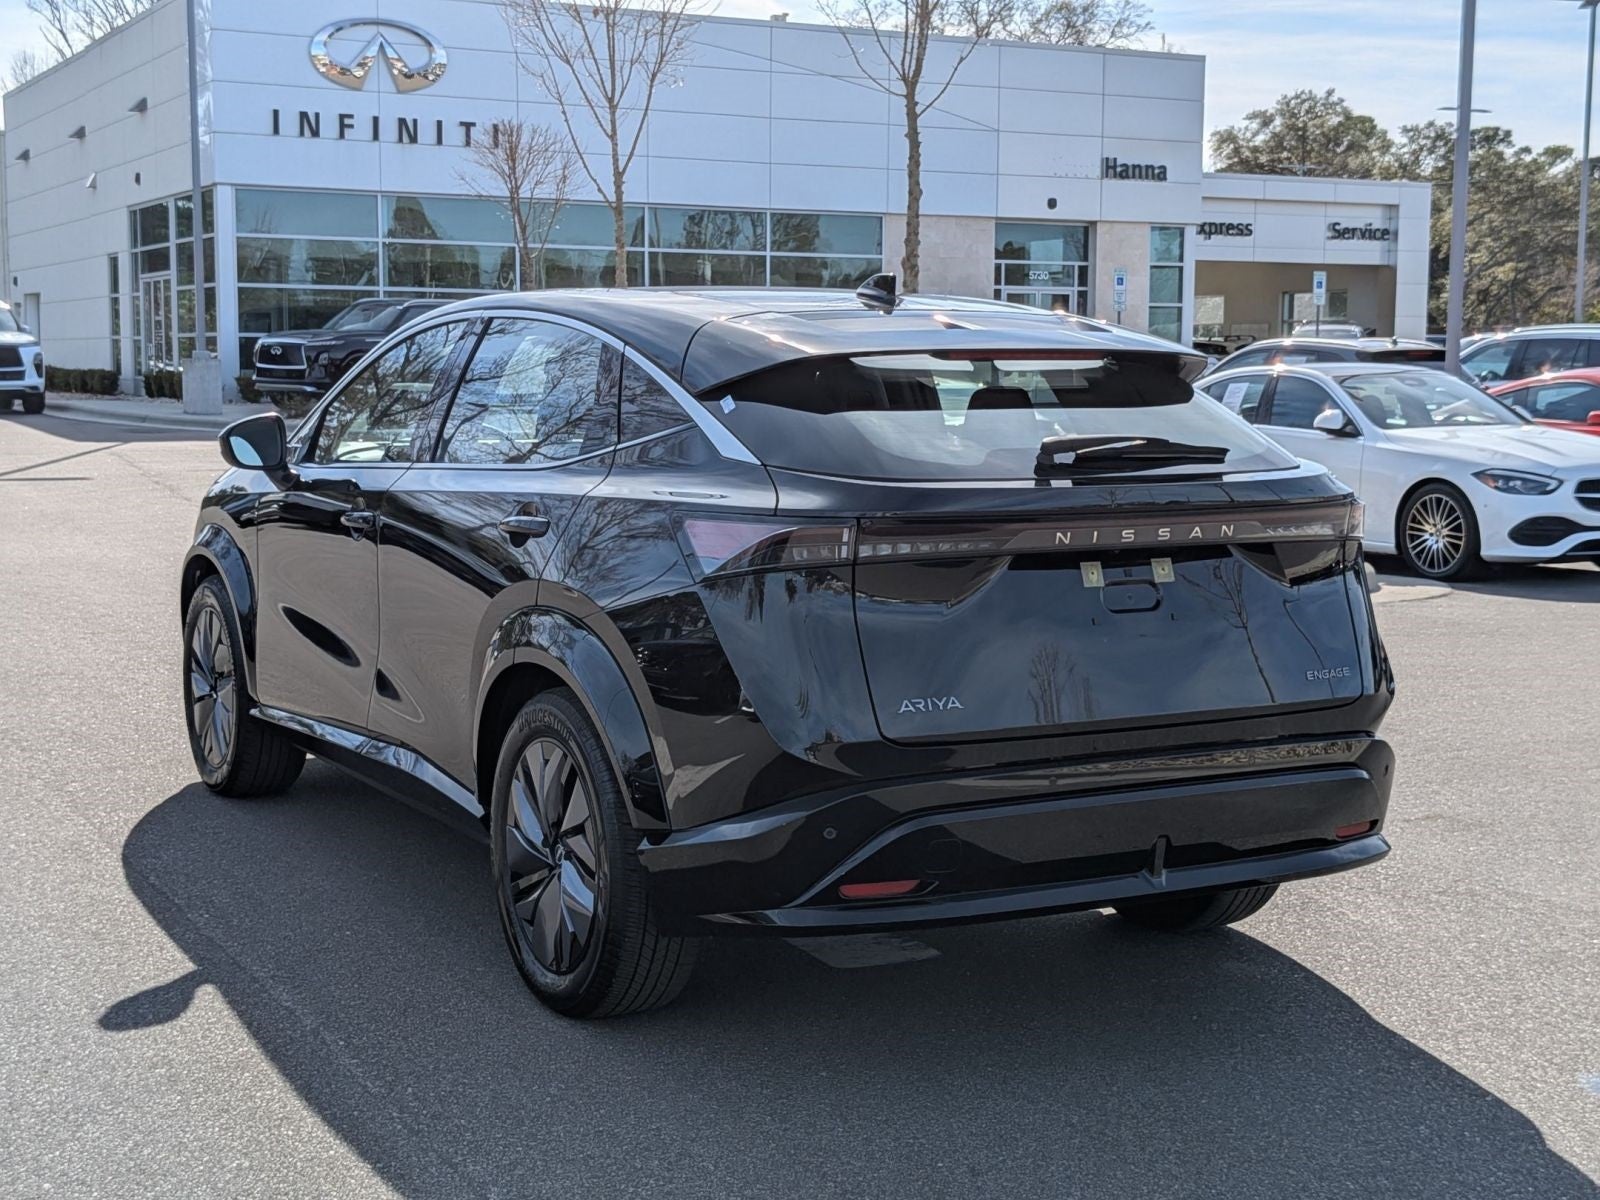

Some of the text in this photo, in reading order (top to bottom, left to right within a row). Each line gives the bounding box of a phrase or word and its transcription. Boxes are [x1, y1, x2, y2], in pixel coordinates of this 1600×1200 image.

[272, 109, 500, 149] INFINITI
[1102, 157, 1168, 182] Hanna
[1196, 221, 1391, 241] xpress Service
[1029, 270, 1049, 280] 5730
[1055, 523, 1235, 545] NISSAN
[1305, 666, 1350, 681] ENGAGE
[897, 696, 965, 714] ARIYA
